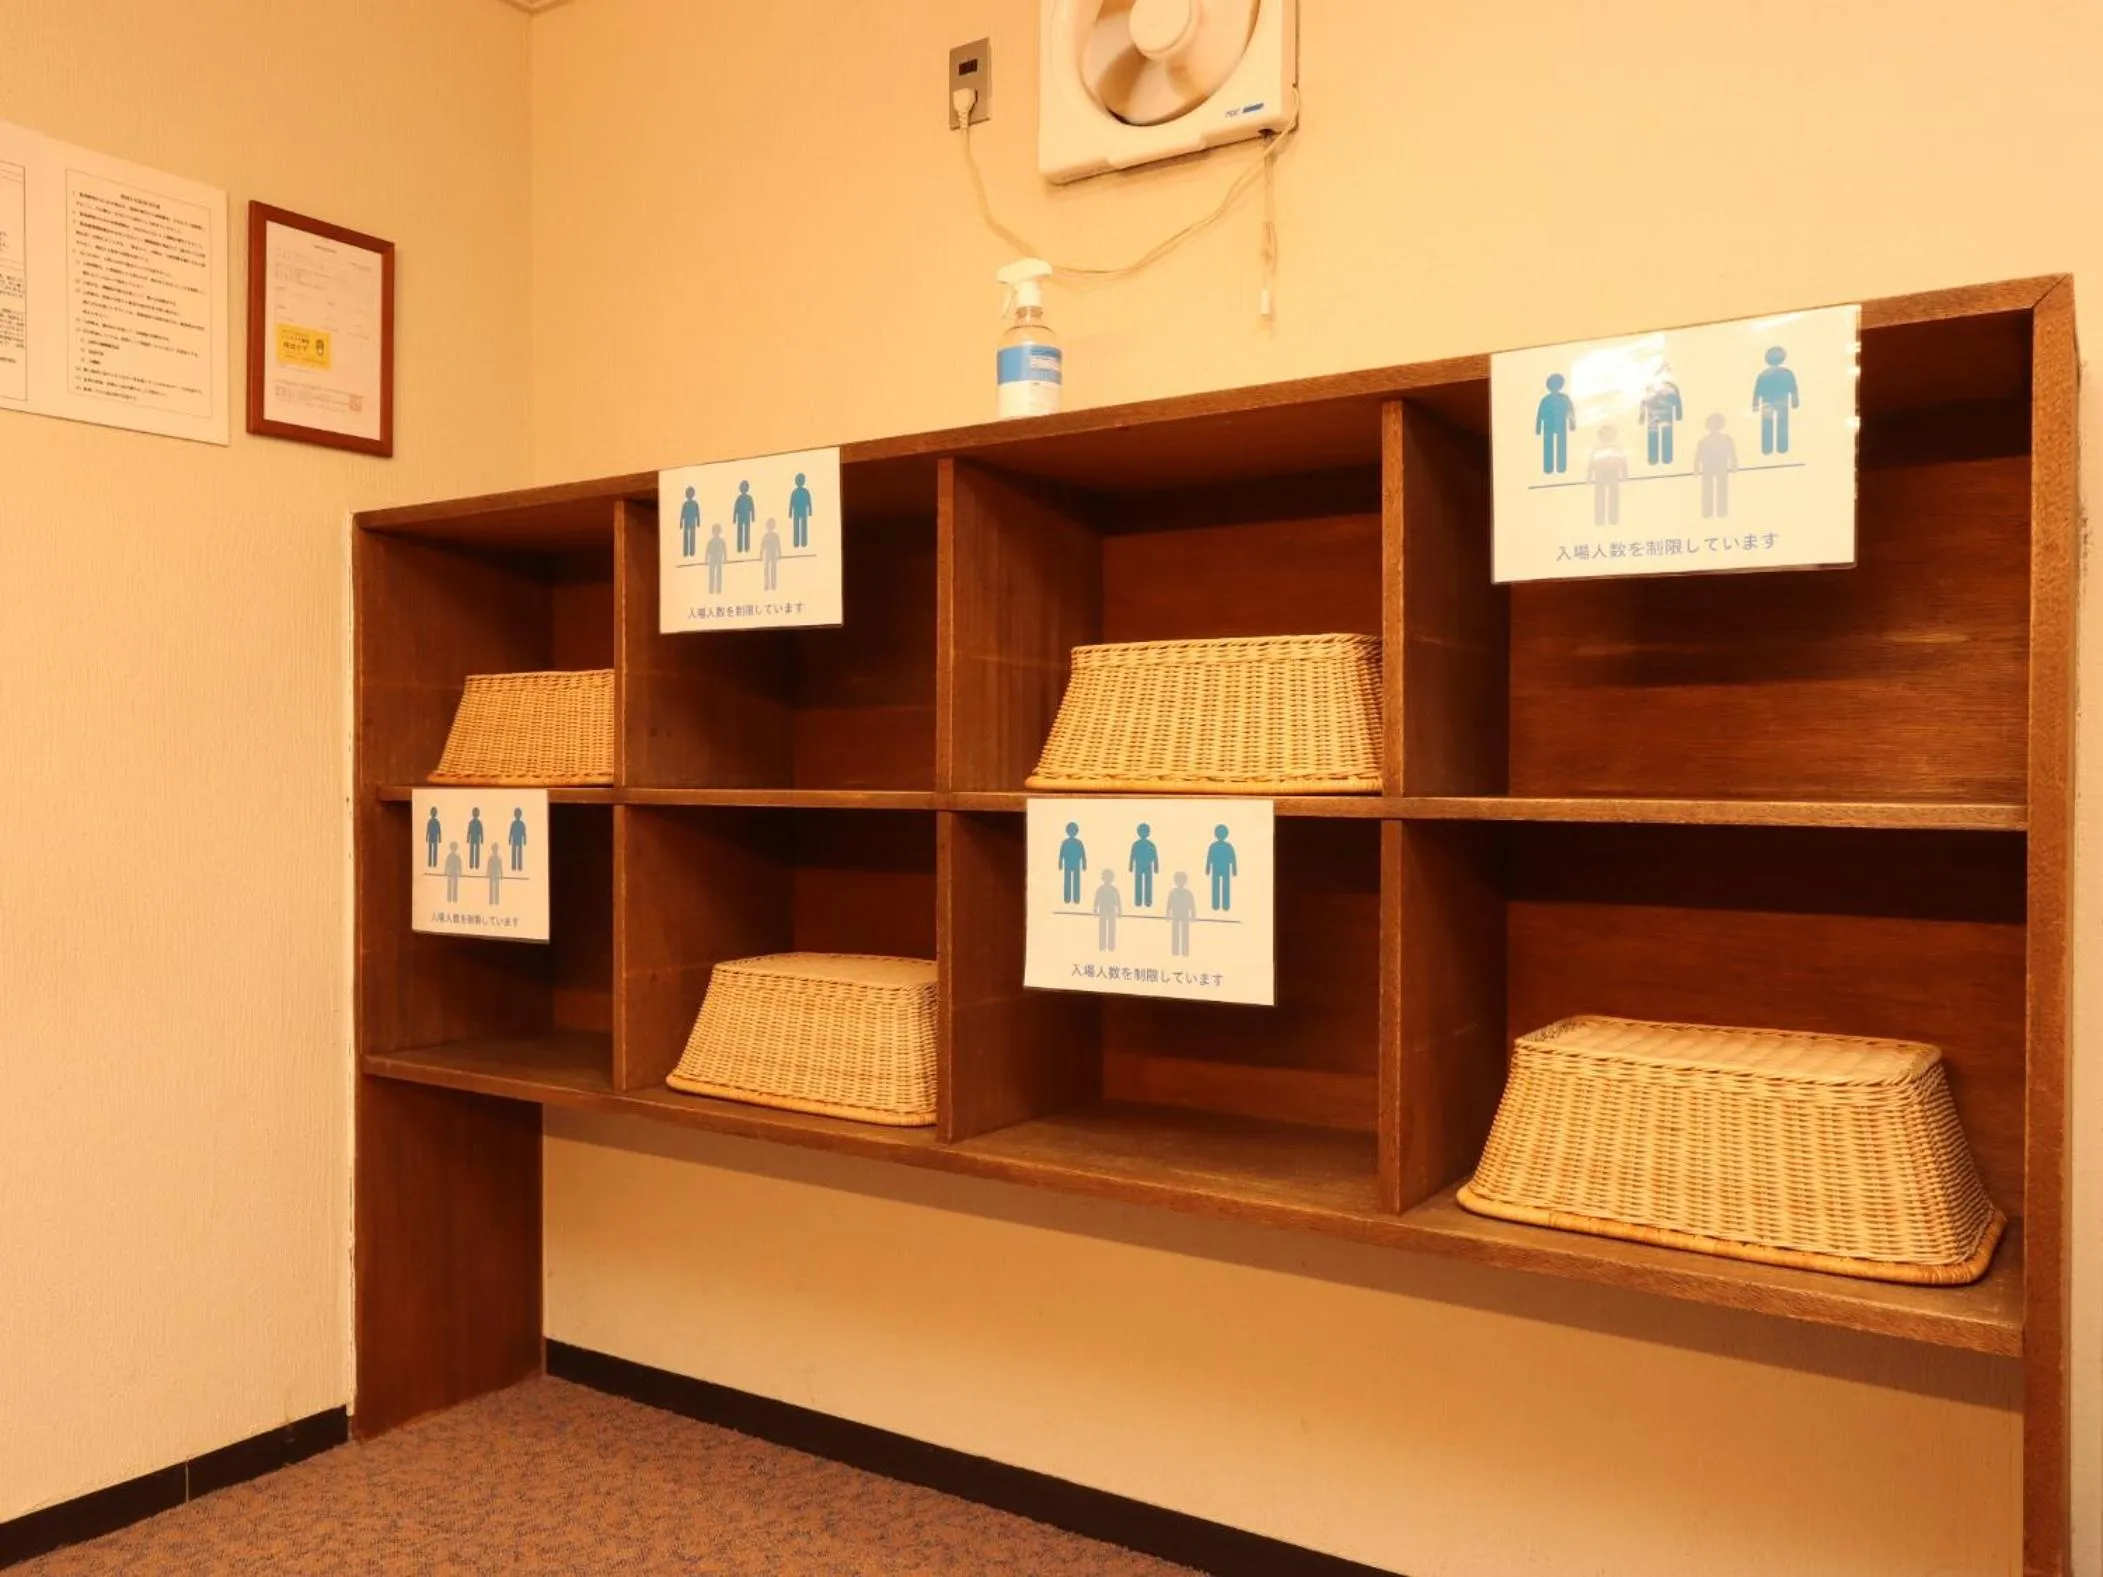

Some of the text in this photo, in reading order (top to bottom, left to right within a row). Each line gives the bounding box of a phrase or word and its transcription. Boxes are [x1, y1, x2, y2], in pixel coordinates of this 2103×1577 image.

[1556, 532, 1778, 560] 入場人数を制限しています
[1071, 964, 1223, 986] 入場人数を制限しています
